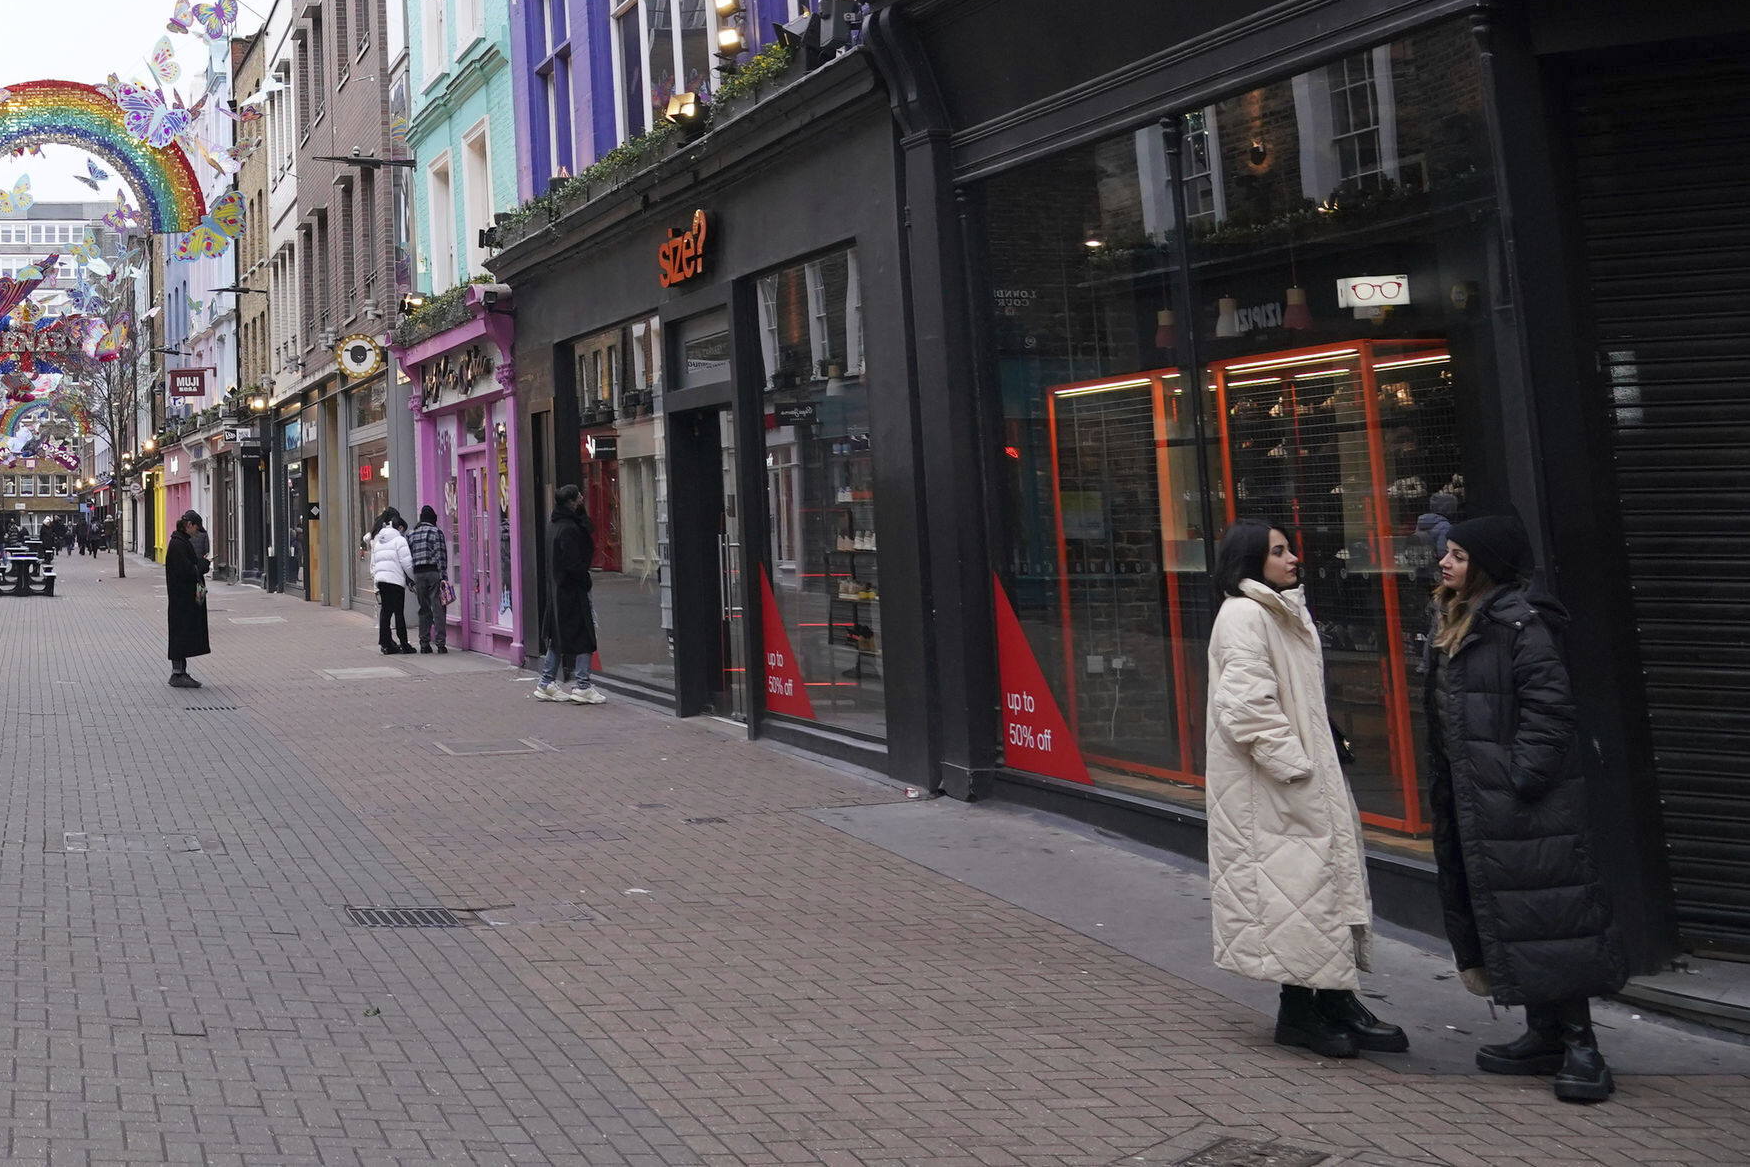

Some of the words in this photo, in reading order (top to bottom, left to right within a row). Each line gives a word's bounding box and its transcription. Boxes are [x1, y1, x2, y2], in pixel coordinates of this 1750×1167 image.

[658, 209, 707, 289] size?
[176, 377, 199, 387] MUJI
[767, 652, 776, 670] up
[768, 675, 783, 695] 50%
[1007, 692, 1022, 715] up
[1023, 691, 1035, 713] to
[1010, 723, 1035, 749] 50%
[1037, 728, 1052, 752] off
